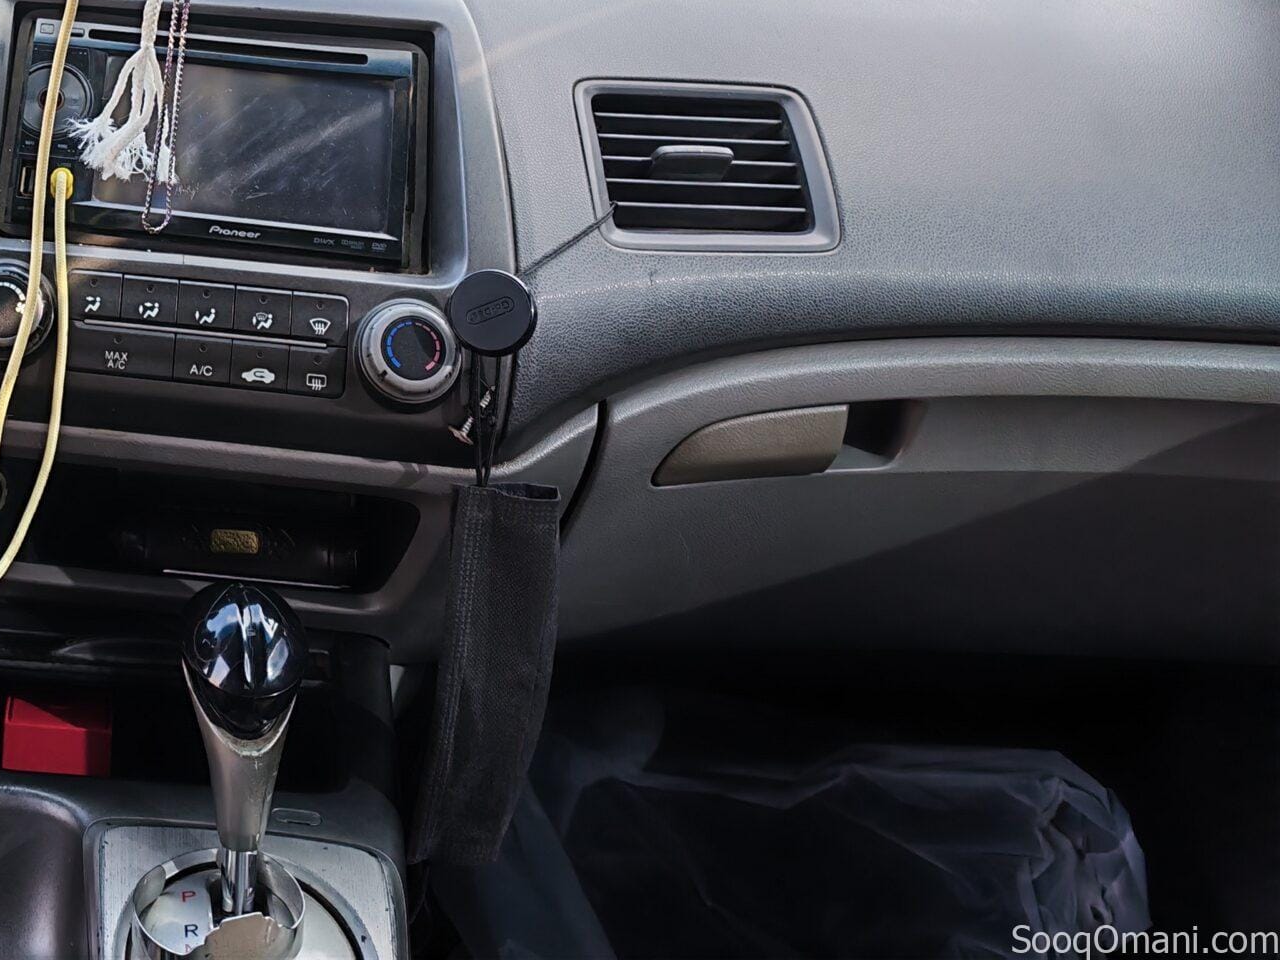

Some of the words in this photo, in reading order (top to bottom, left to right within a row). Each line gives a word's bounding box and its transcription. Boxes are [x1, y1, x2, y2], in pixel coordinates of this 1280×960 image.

[208, 224, 262, 240] Pioneer
[104, 350, 128, 361] MAX
[106, 359, 126, 370] A/C
[189, 364, 213, 377] A/C
[181, 890, 196, 903] P
[184, 923, 199, 938] R
